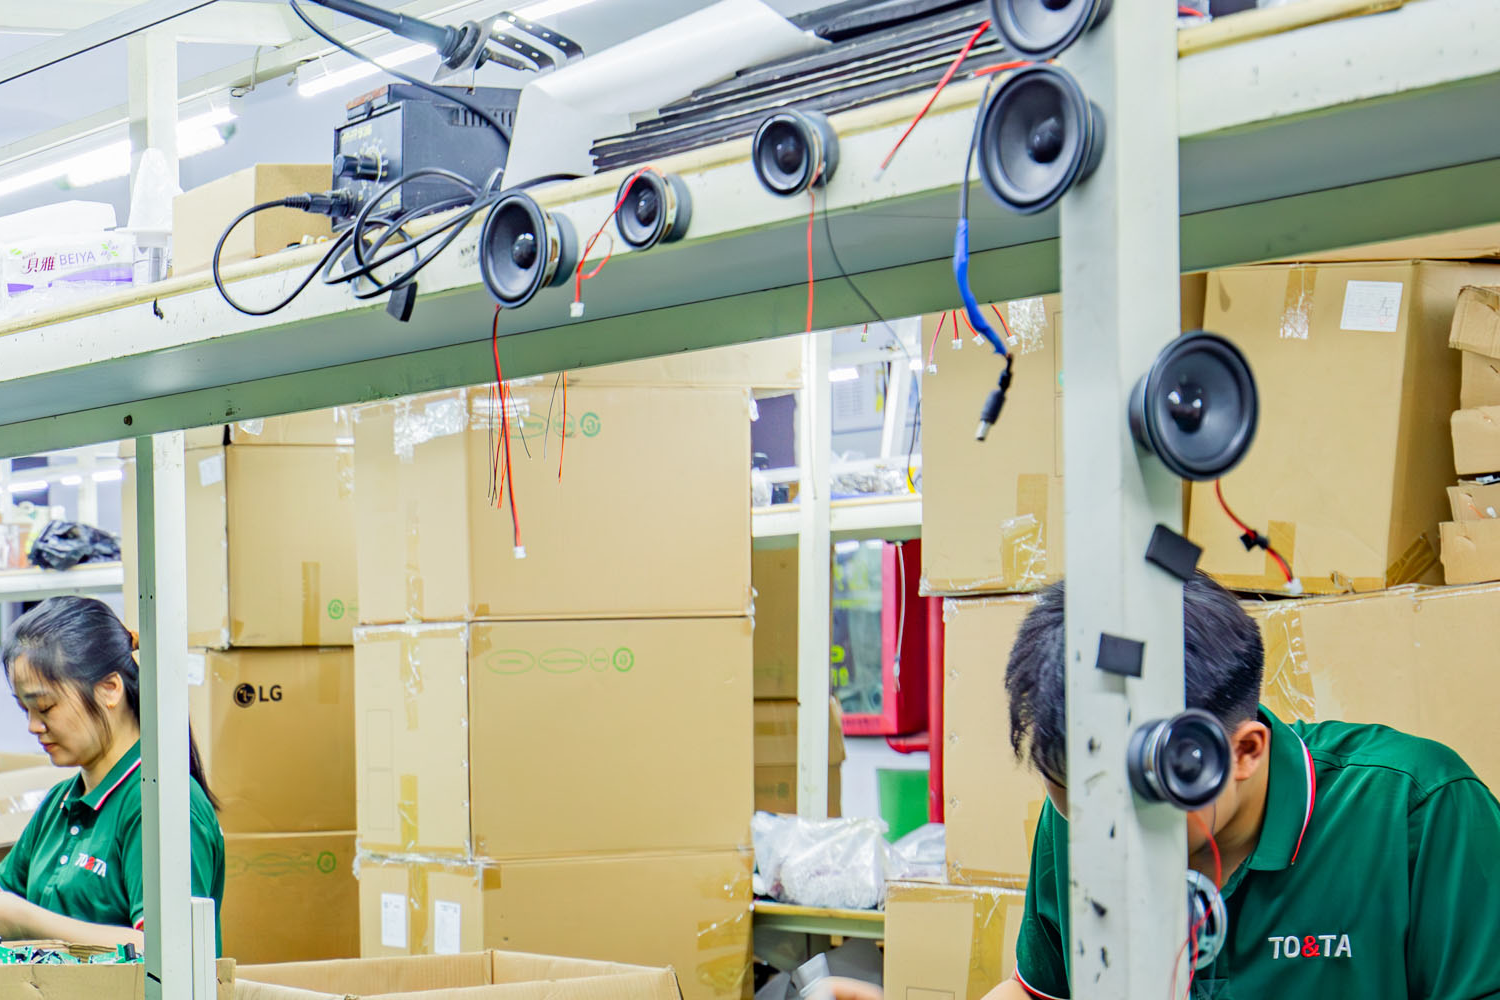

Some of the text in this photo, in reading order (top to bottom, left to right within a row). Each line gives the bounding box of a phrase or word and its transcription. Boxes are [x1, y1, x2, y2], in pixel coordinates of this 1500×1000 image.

[59, 250, 96, 267] BEIYA
[258, 684, 283, 703] LG
[1267, 933, 1352, 960] TO&TA
